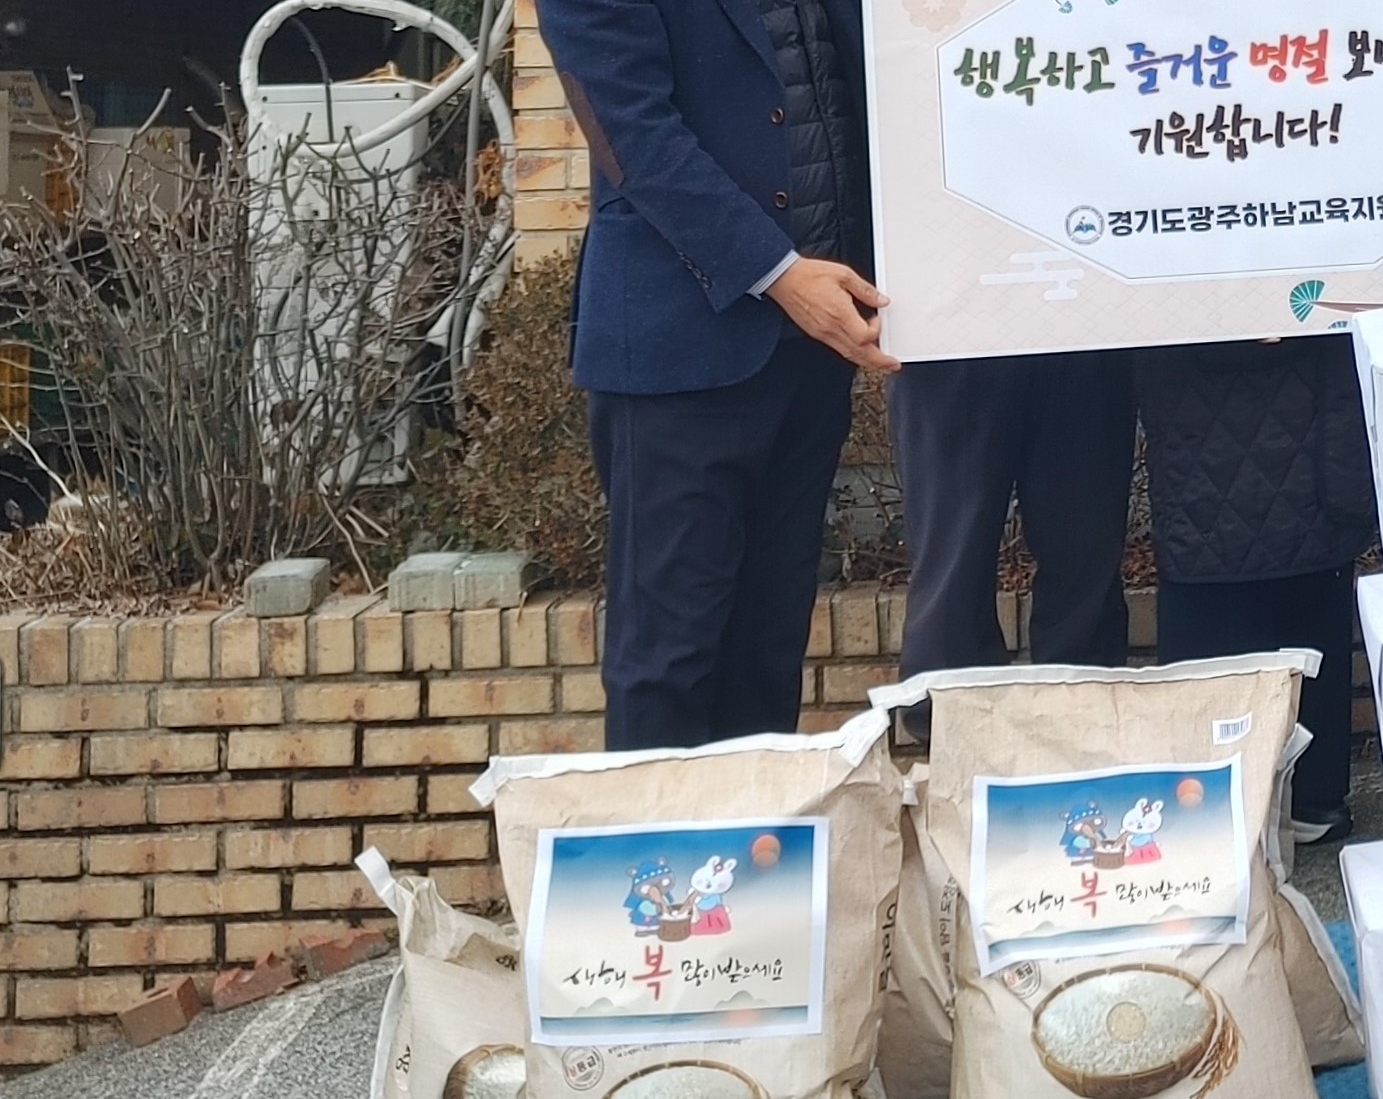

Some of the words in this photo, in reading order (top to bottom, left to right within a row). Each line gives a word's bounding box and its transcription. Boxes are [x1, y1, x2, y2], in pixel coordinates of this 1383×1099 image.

[953, 36, 1116, 105] 행복하고
[1124, 34, 1239, 96] 즐거운
[1248, 29, 1331, 84] 명절
[1128, 103, 1342, 163] 기원합니다!
[1070, 870, 1108, 919] 복
[631, 944, 673, 1002] 복
